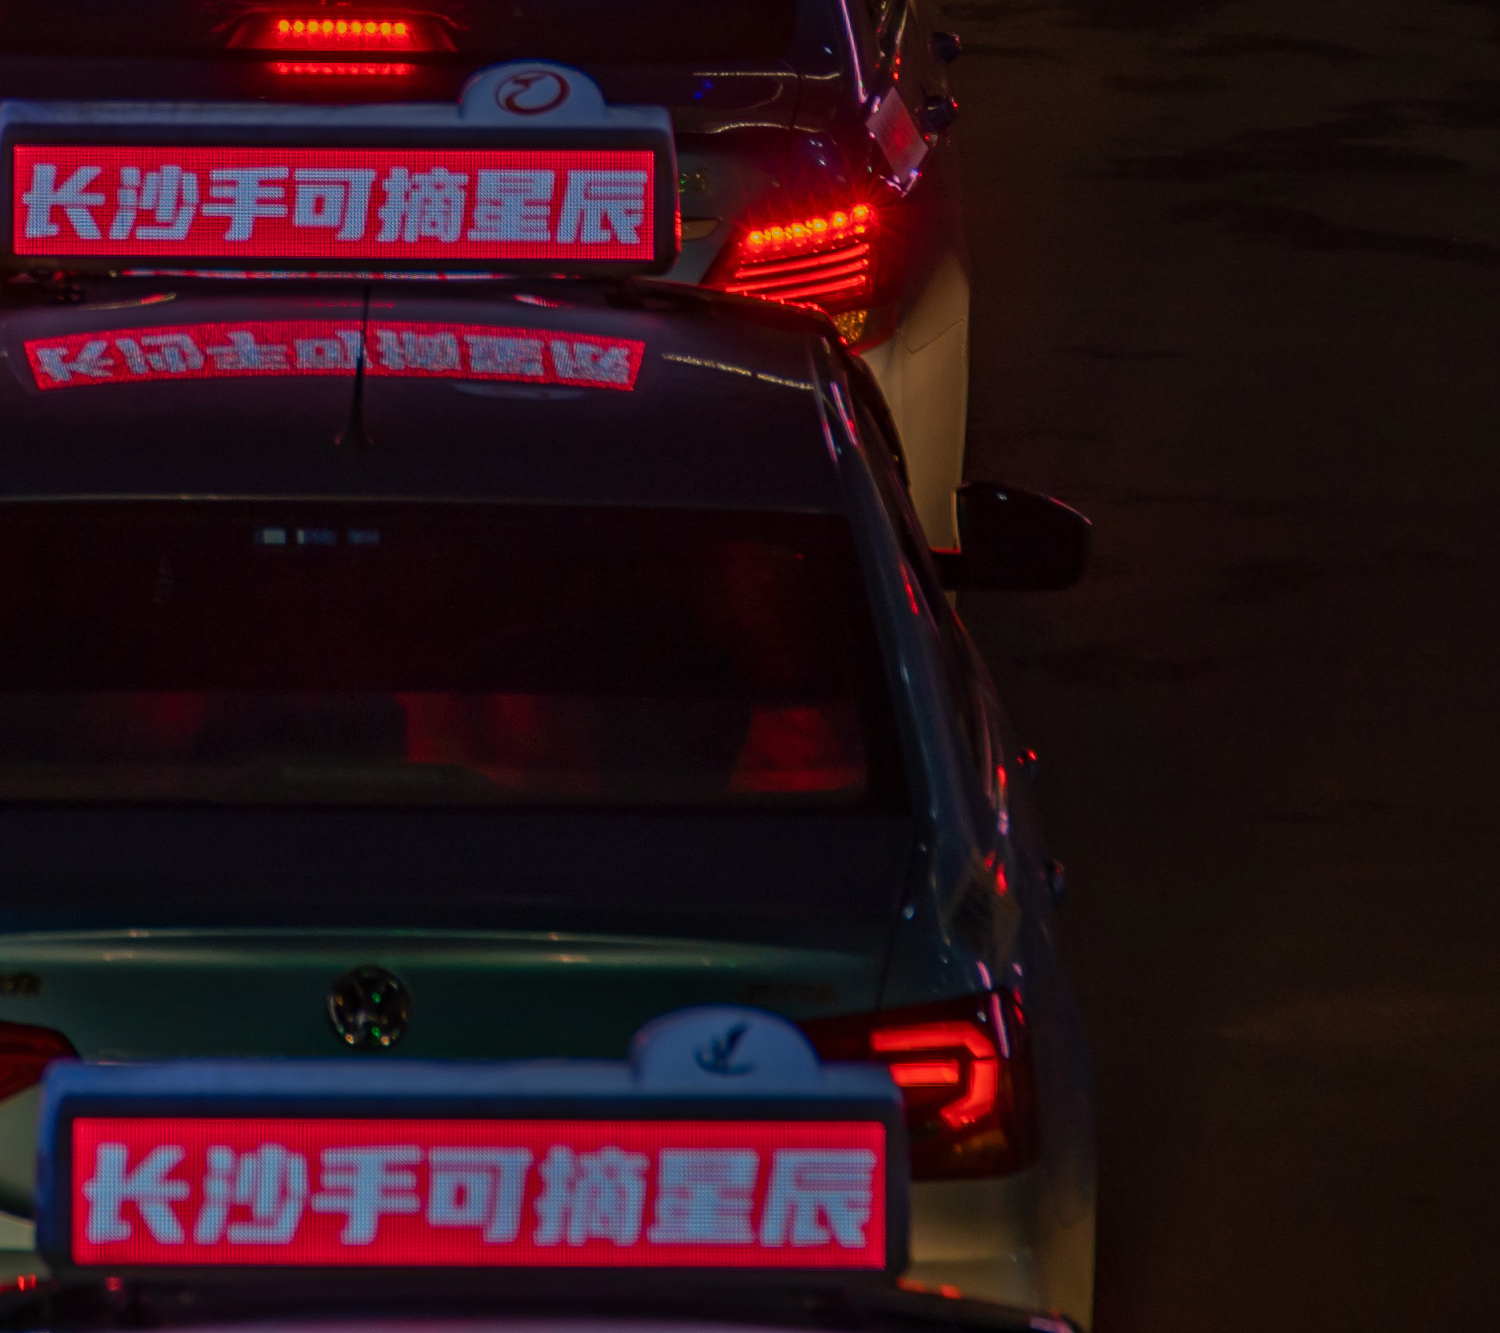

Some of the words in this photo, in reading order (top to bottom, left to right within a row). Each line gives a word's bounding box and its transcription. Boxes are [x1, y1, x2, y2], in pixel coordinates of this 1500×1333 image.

[23, 164, 647, 243] 长沙手可摘星辰
[85, 1144, 874, 1245] 长沙手可摘星辰
